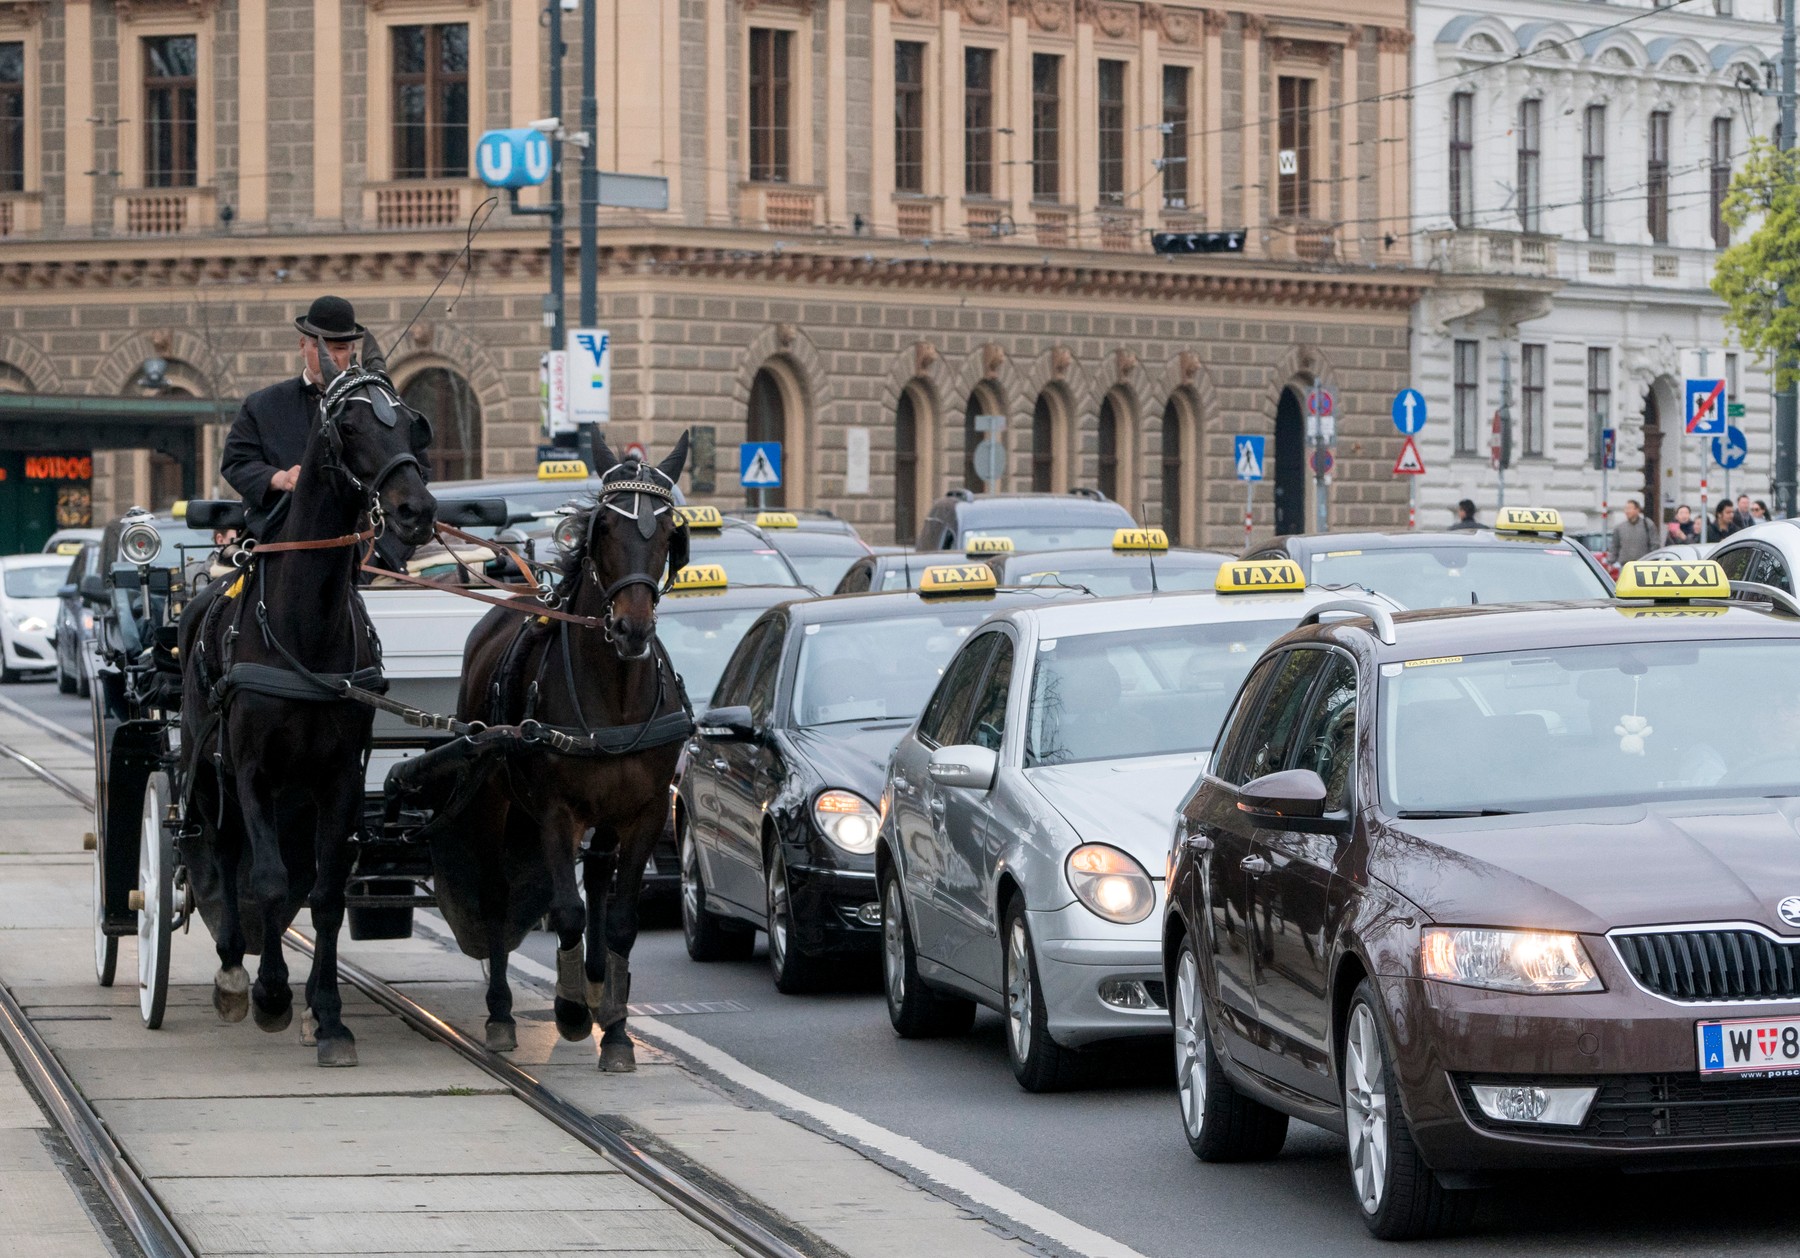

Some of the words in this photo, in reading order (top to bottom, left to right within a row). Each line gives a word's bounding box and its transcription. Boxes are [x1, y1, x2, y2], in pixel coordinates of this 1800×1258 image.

[482, 143, 512, 182] U
[525, 140, 548, 179] U
[546, 464, 581, 473] TAXI
[1508, 510, 1557, 524] TAXI
[975, 540, 1010, 551] TAXI
[1123, 532, 1162, 544] TAXI
[932, 567, 986, 583] TAXI
[1234, 567, 1294, 585] TAXI
[1636, 565, 1717, 585] TAXI
[1710, 1053, 1719, 1063] A
[1729, 1028, 1753, 1063] W
[1781, 1026, 1800, 1059] 8
